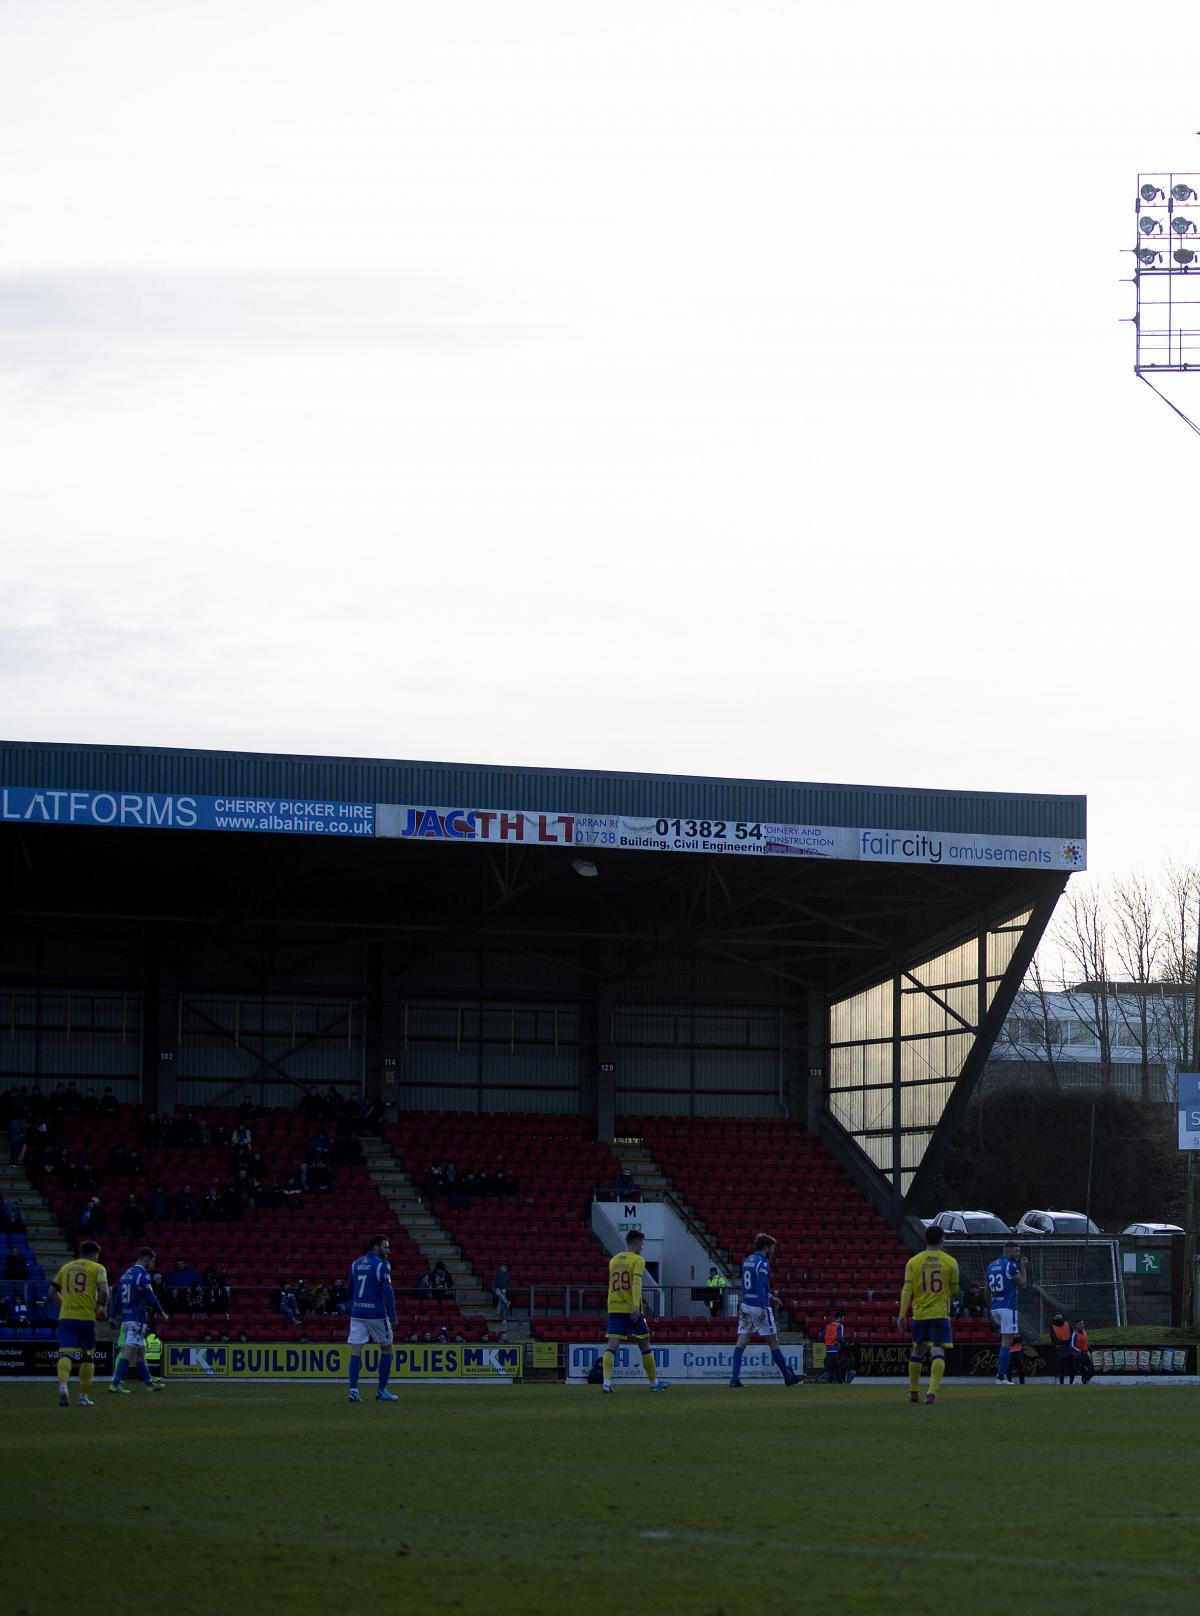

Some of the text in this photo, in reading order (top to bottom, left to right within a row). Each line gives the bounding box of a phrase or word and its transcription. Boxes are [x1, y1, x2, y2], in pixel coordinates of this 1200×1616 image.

[214, 800, 373, 819] CHERRY PICKER HIRE
[215, 815, 373, 835] www.albahire.co.uk
[576, 819, 608, 830] ARRAN
[655, 818, 727, 839] 01382
[801, 828, 821, 838] AND
[575, 830, 617, 845] 01738
[620, 836, 768, 857] Building, Civil Engineering
[861, 832, 1052, 864] faircity amusements
[624, 1205, 636, 1218] M
[66, 1272, 87, 1295] 19
[357, 1275, 367, 1298] 7
[612, 1271, 631, 1292] 29
[743, 1270, 752, 1290] 8
[921, 1270, 943, 1294] 16
[988, 1273, 1004, 1292] 23
[170, 1348, 227, 1370] MKM
[232, 1349, 457, 1374] BUILDING UPLIES
[464, 1347, 518, 1369] MKM
